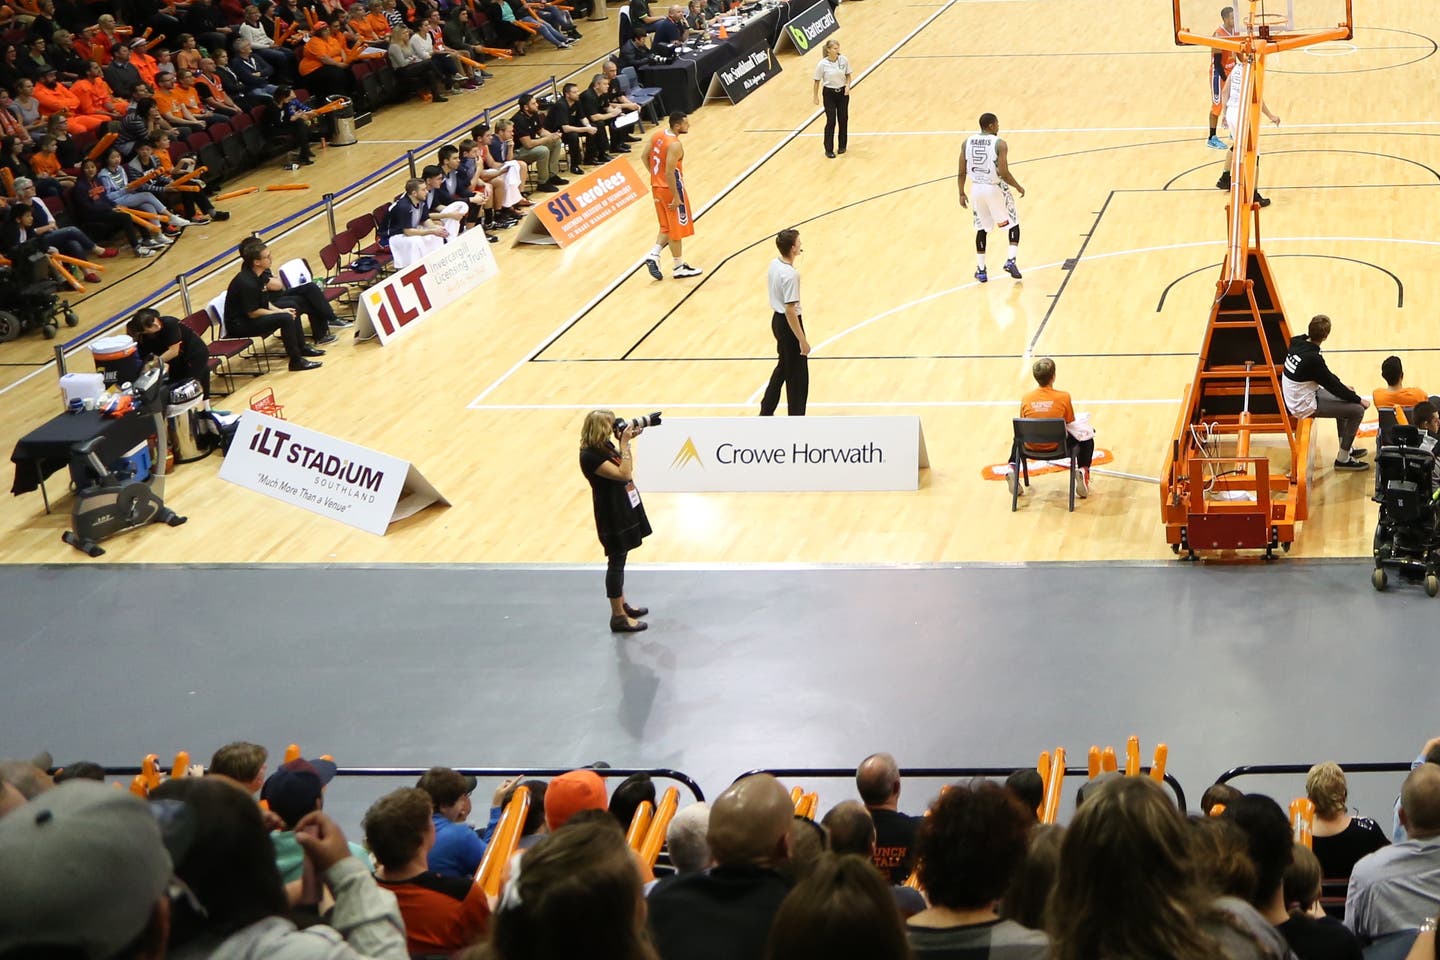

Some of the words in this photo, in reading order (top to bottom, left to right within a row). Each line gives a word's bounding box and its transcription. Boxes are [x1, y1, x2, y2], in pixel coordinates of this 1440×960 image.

[802, 9, 835, 40] bartercard
[720, 72, 734, 86] The
[731, 53, 756, 79] Southland
[753, 50, 768, 66] Times
[972, 146, 988, 164] 5
[547, 193, 577, 222] SIT
[576, 172, 626, 208] zerofees
[430, 242, 470, 272] Invercargill
[434, 260, 469, 284] Licensing
[467, 248, 487, 264] Trust
[370, 264, 432, 336] iLT
[250, 425, 290, 458] iLT
[286, 443, 384, 492] STADiUM
[716, 443, 785, 464] Crowe
[792, 442, 882, 464] Horwath
[280, 481, 298, 496] More
[299, 488, 315, 502] Than
[317, 496, 322, 504] a
[314, 476, 375, 504] SOUTHLAND
